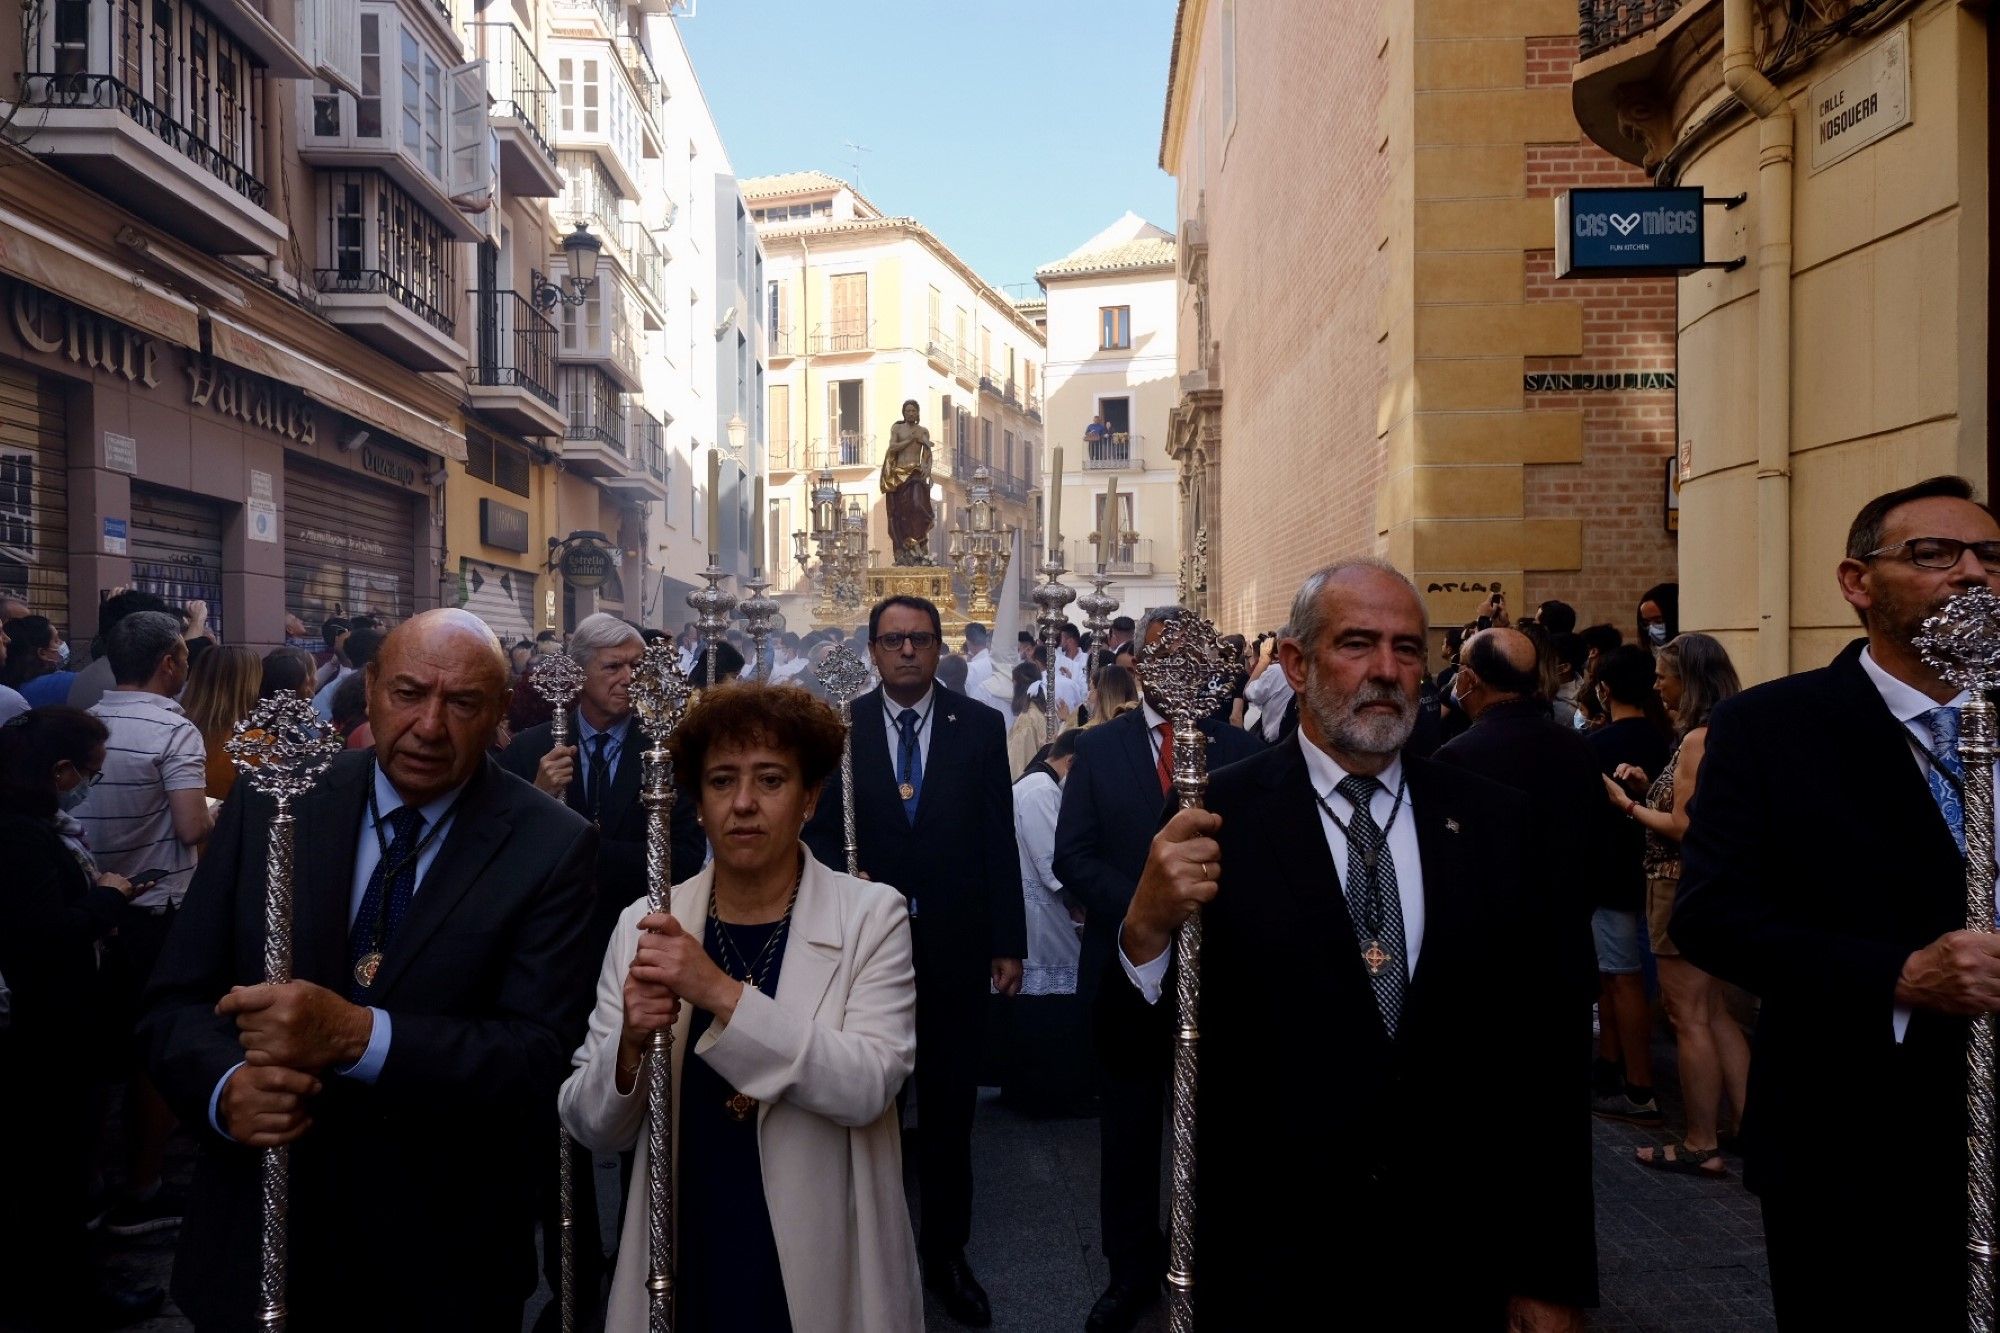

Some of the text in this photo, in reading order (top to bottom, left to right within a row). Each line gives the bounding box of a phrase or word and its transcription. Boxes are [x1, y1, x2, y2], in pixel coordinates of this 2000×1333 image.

[1819, 89, 1845, 118] CALLE
[1819, 92, 1879, 145] NOSQUERA
[1624, 243, 1650, 251] KITCHEN
[1526, 373, 1573, 391] SAN
